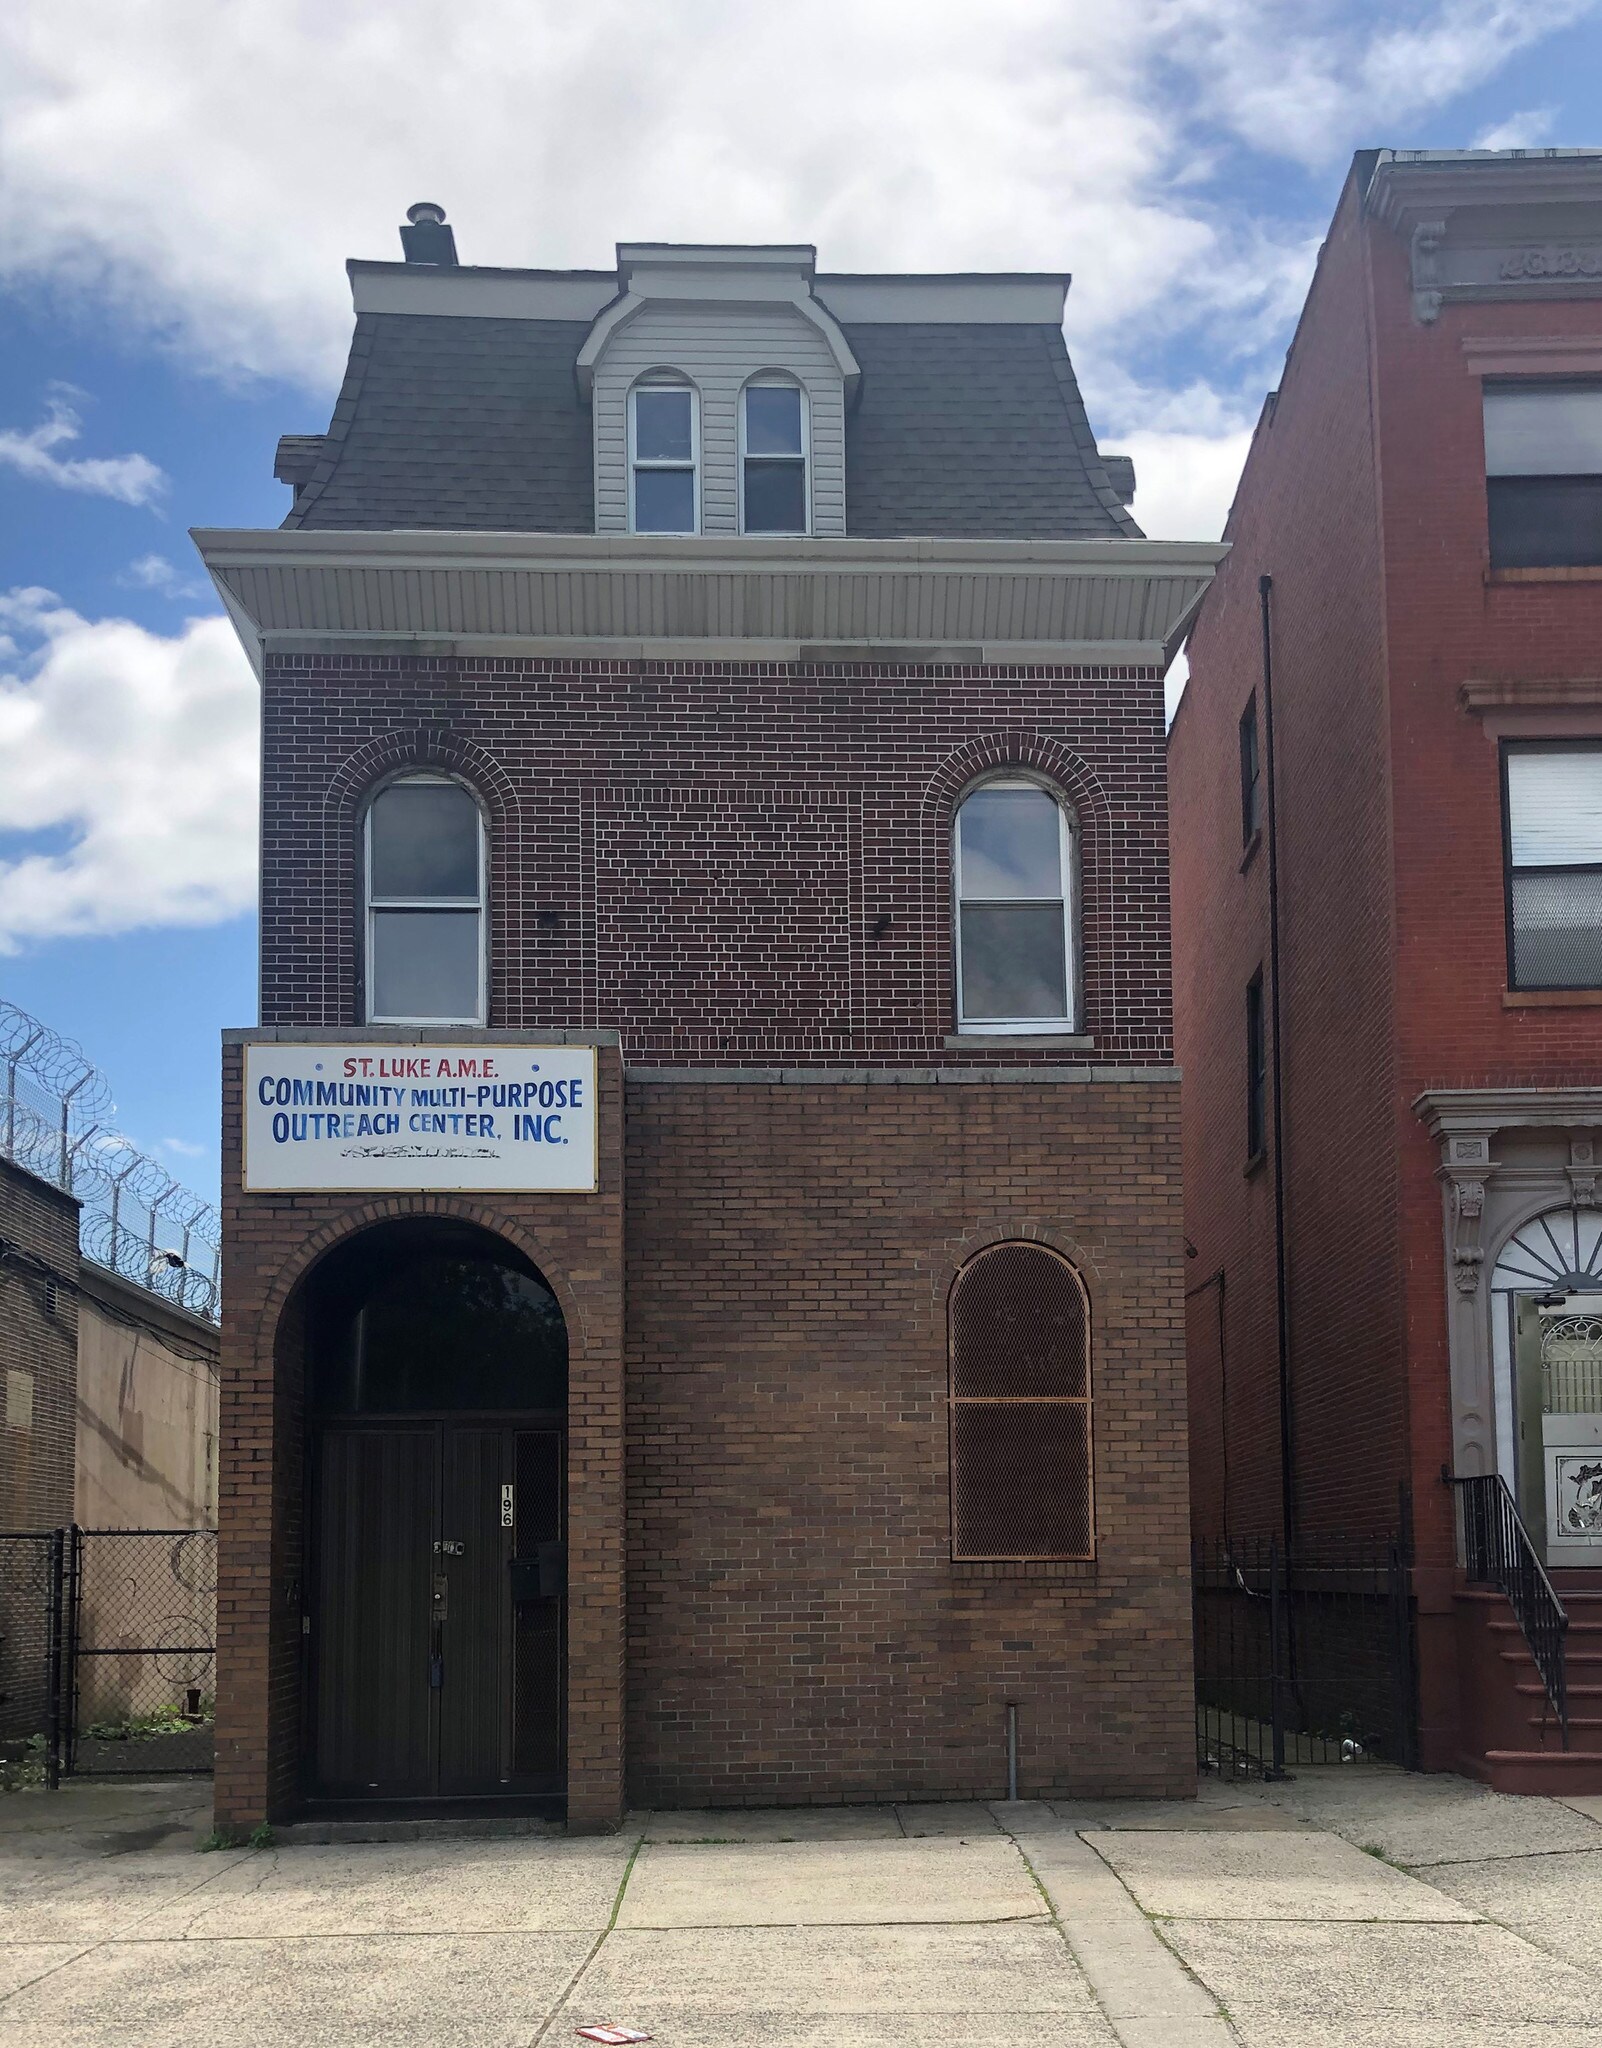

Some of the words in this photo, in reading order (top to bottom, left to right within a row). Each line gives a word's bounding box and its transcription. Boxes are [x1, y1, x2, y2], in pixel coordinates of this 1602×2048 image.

[343, 1057, 375, 1078] ST.
[379, 1058, 430, 1078] LUKE
[436, 1058, 499, 1078] A.M.E.
[258, 1075, 406, 1107] COMMUNITY
[411, 1079, 583, 1108] MULTI-PURPOSE
[272, 1112, 399, 1144] OUTREACH
[514, 1114, 569, 1145] INC.
[503, 1486, 512, 1526] 196
